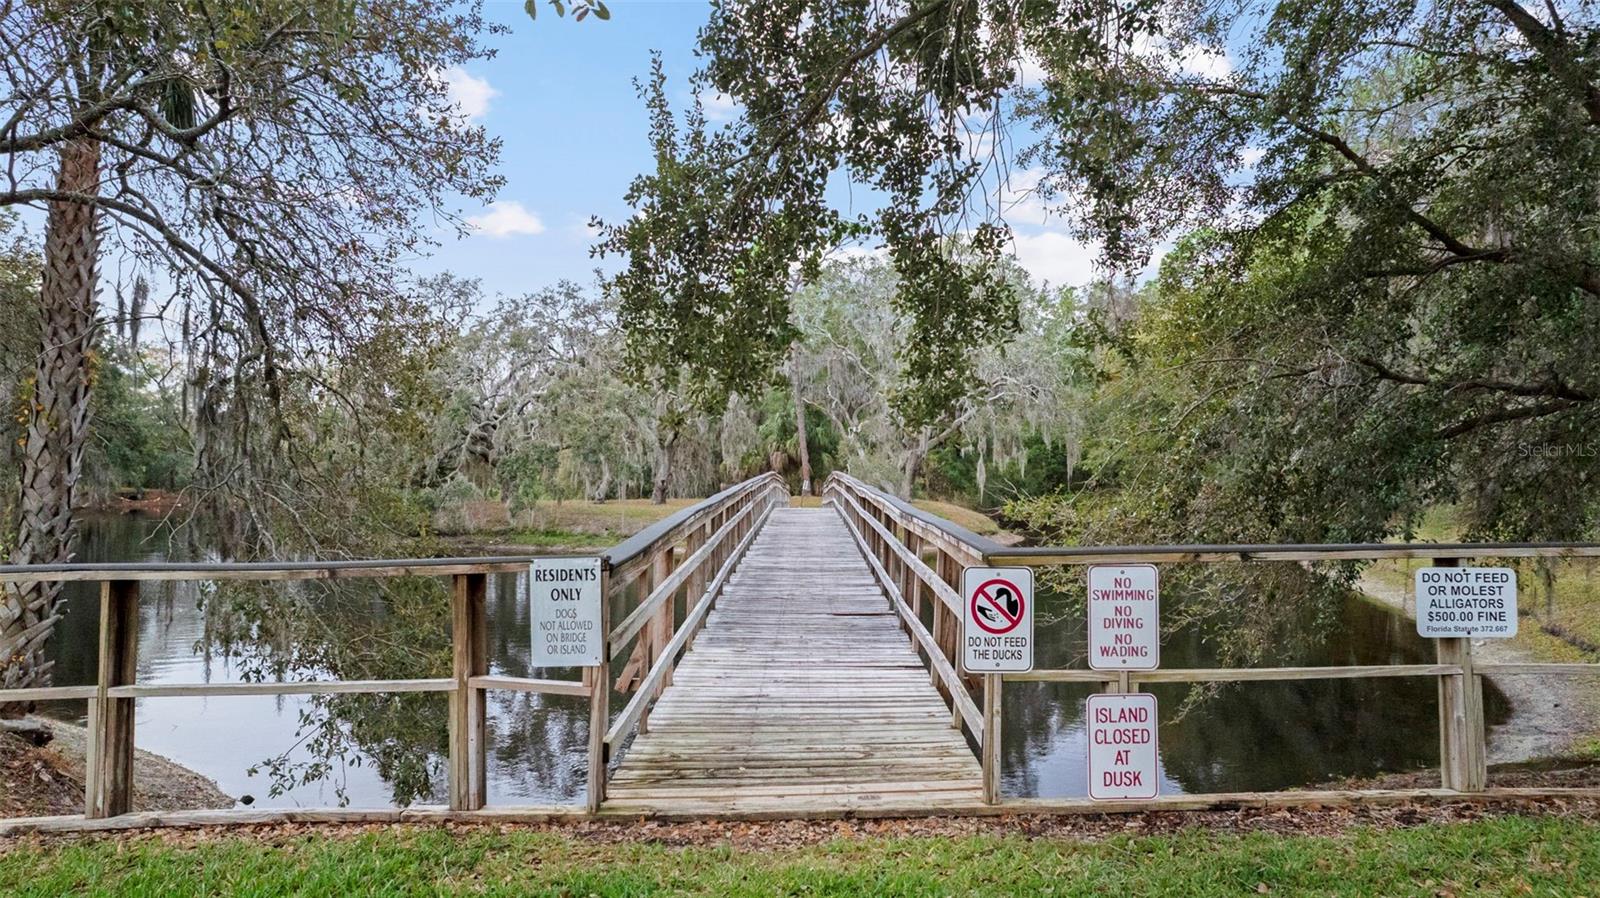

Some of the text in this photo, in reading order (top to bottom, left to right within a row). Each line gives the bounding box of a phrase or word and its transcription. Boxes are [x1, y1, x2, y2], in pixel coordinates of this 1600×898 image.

[535, 568, 597, 582] RESIDENTS
[1422, 572, 1509, 583] DO NOT FEED
[1114, 577, 1132, 588] NO
[551, 588, 582, 601] ONLY
[1092, 589, 1154, 601] SWIMMING
[1428, 585, 1504, 596] OR MOLEST
[1429, 598, 1504, 609] ALLIGATORS
[1114, 605, 1132, 617] NO
[1427, 611, 1506, 622] $500.00 FINE
[540, 621, 593, 631] NOT ALLOWED
[1103, 617, 1143, 629] DIVING
[1426, 625, 1508, 633] Florida Statute 372.667
[546, 632, 586, 643] ON BRIDGE
[968, 636, 1027, 647] DO NOT FEED
[1114, 633, 1132, 645] NO
[547, 644, 586, 655] OR ISLAND
[973, 649, 1023, 660] THE DUCKS
[1100, 645, 1148, 657] WADING
[1095, 707, 1148, 724] ISLAND
[1094, 728, 1150, 745] CLOSED
[1114, 750, 1130, 765] AT
[1103, 771, 1142, 787] DUSK
